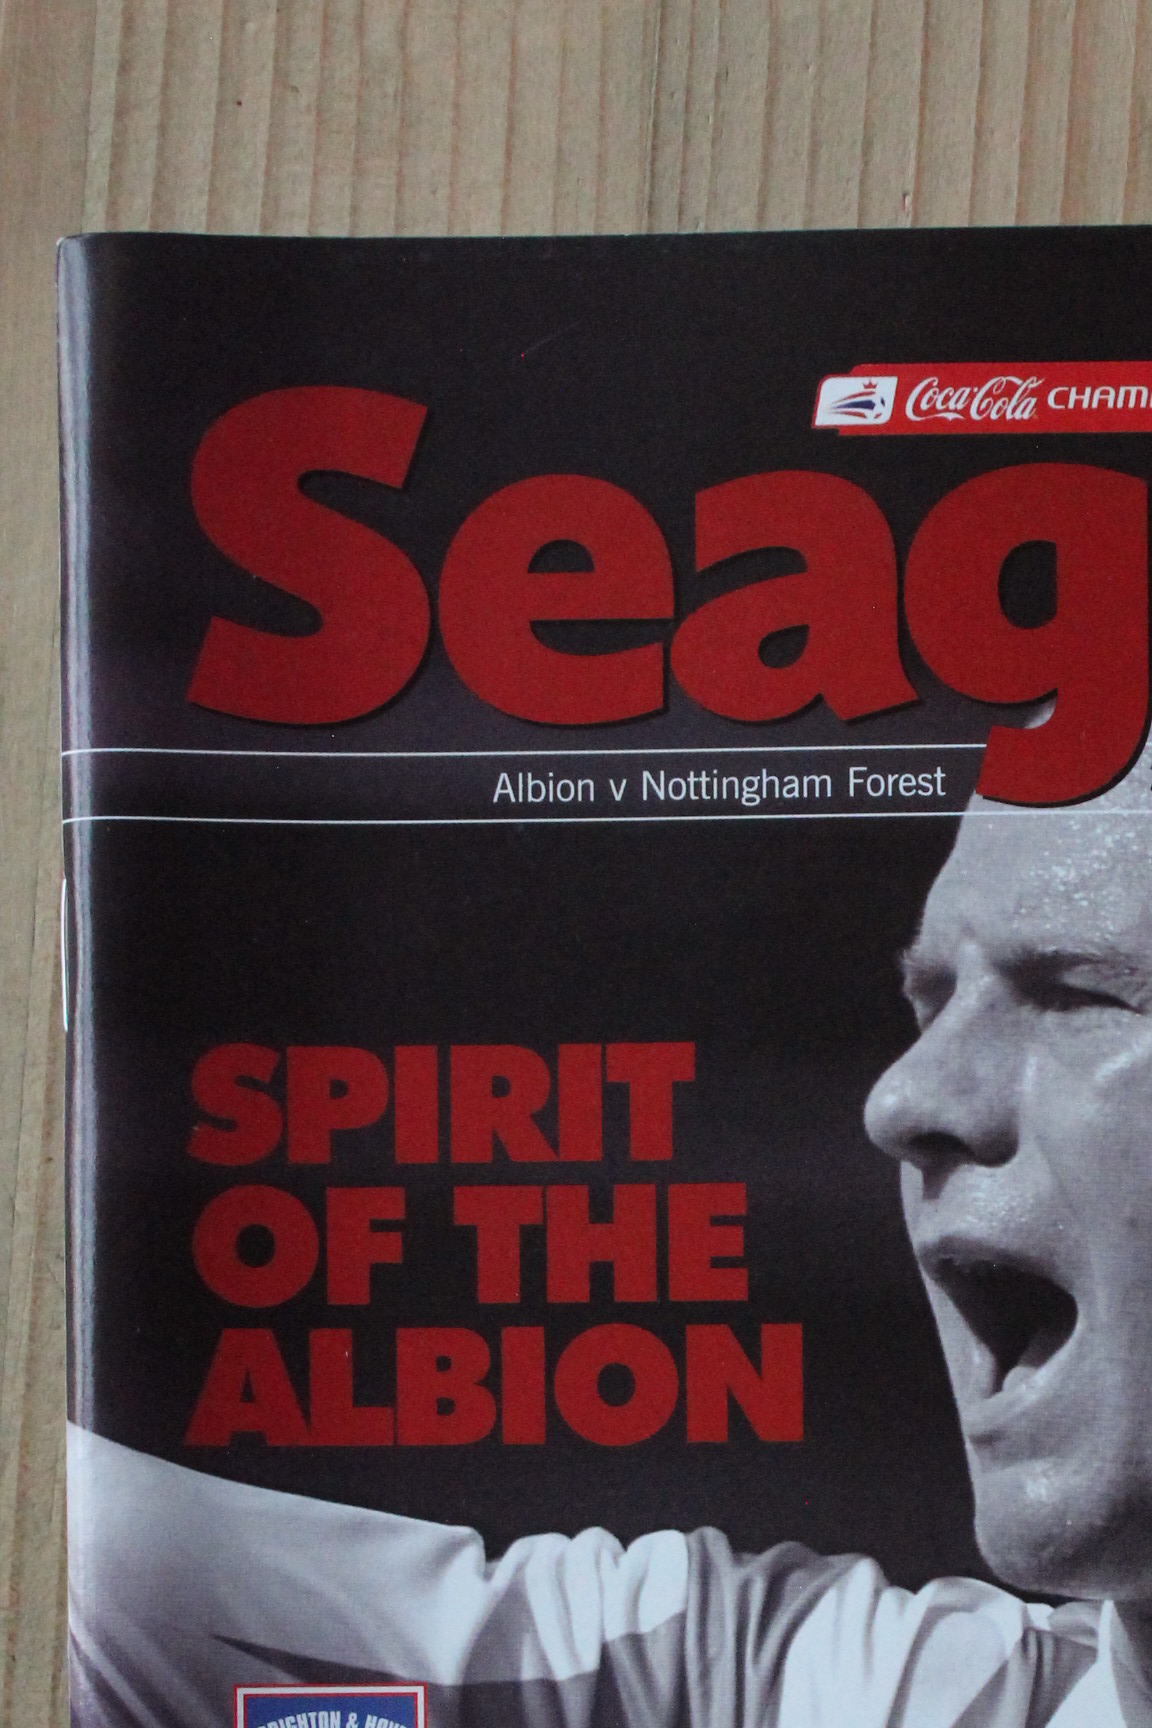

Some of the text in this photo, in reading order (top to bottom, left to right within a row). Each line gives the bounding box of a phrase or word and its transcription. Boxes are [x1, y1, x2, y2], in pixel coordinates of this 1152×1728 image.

[493, 766, 946, 806] Albion v Nottingham Forest
[186, 1041, 695, 1166] SPIRIT
[193, 1182, 749, 1309] OF THE
[184, 1322, 804, 1447] ALBION
